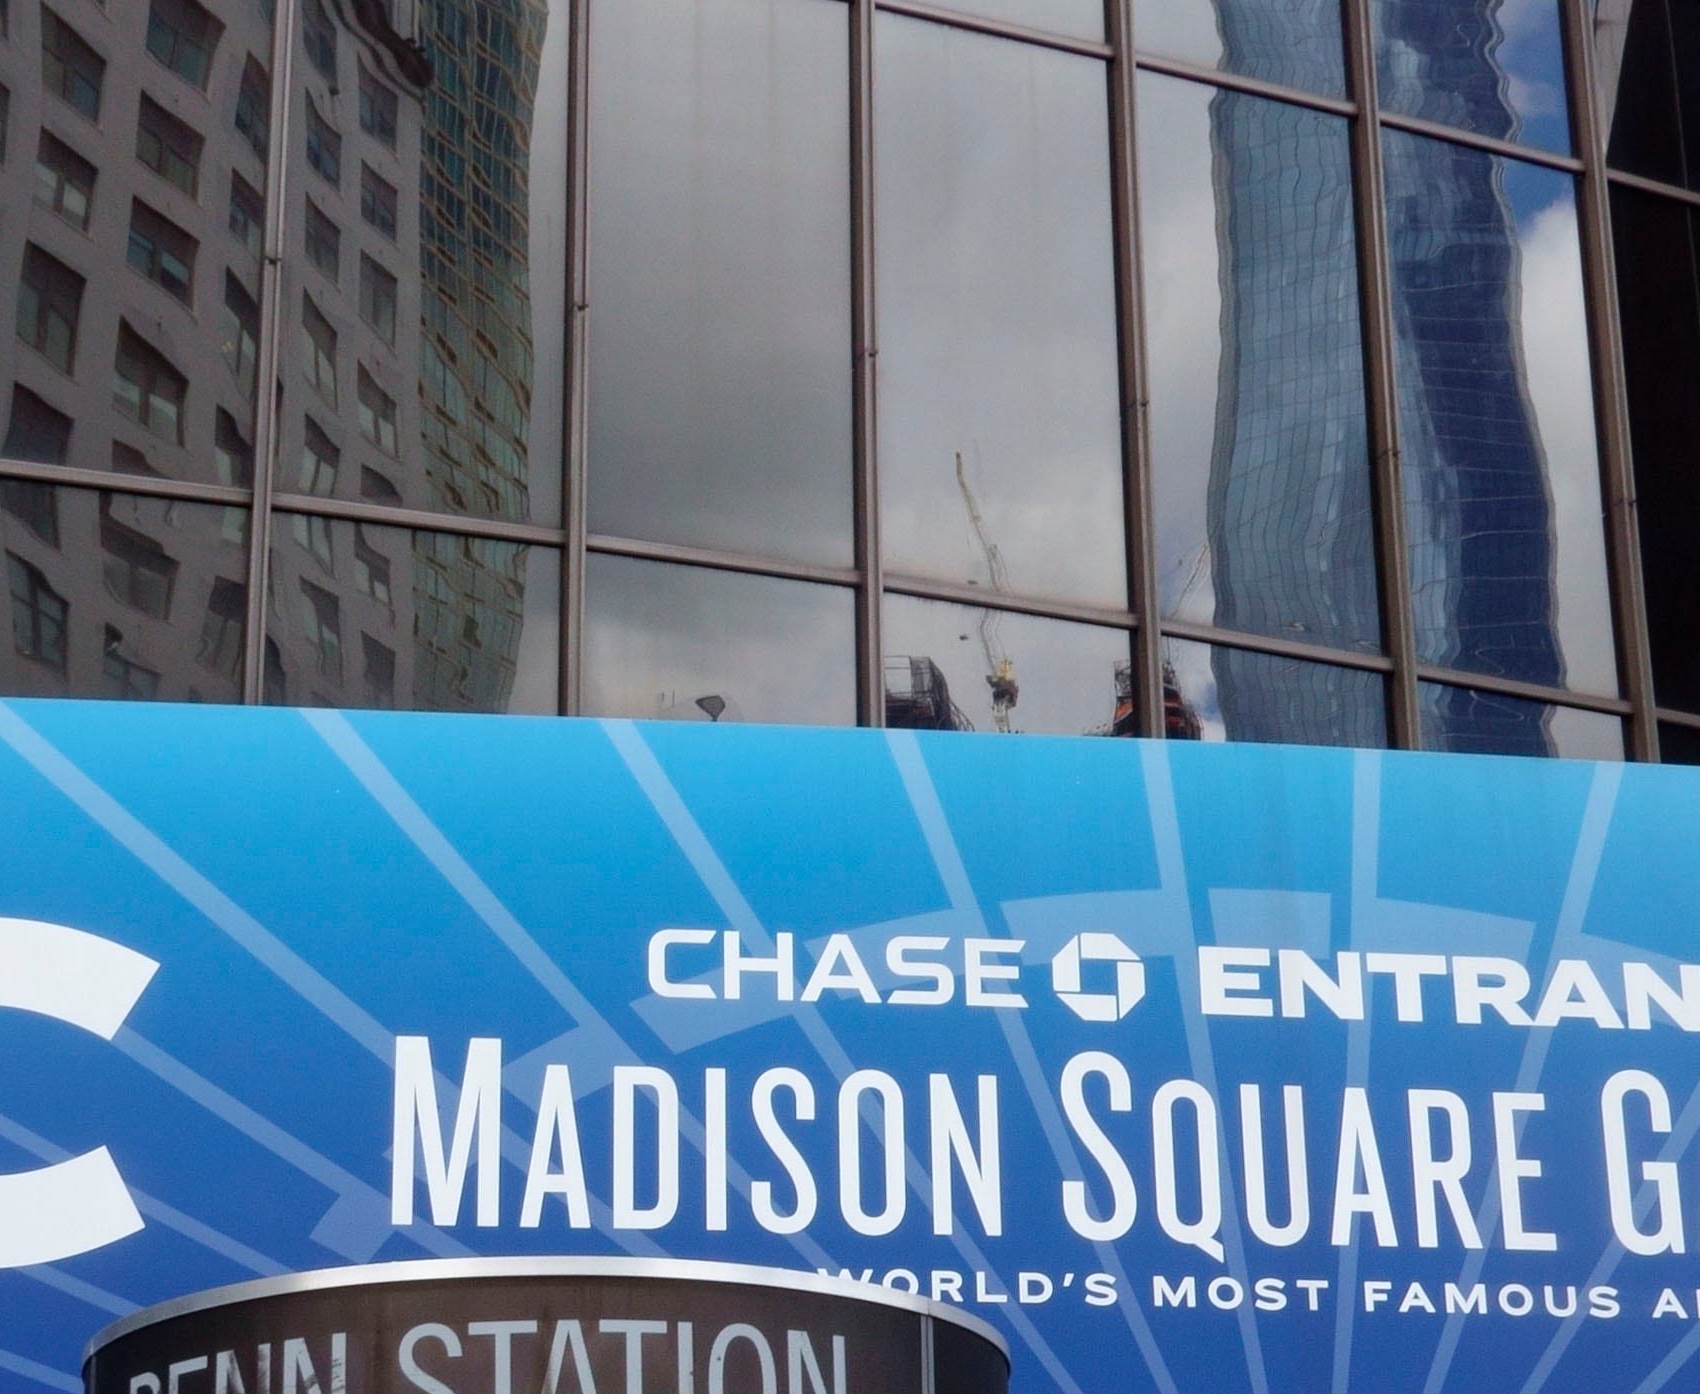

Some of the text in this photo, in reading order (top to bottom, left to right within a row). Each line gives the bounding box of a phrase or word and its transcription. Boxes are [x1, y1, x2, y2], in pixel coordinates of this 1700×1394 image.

[649, 930, 1028, 1008] CHASE
[392, 1036, 1002, 1236] MADISON
[1061, 1052, 1557, 1262] SQUARE
[1154, 1276, 1328, 1310] MOST
[1365, 1282, 1620, 1318] FAMOUS
